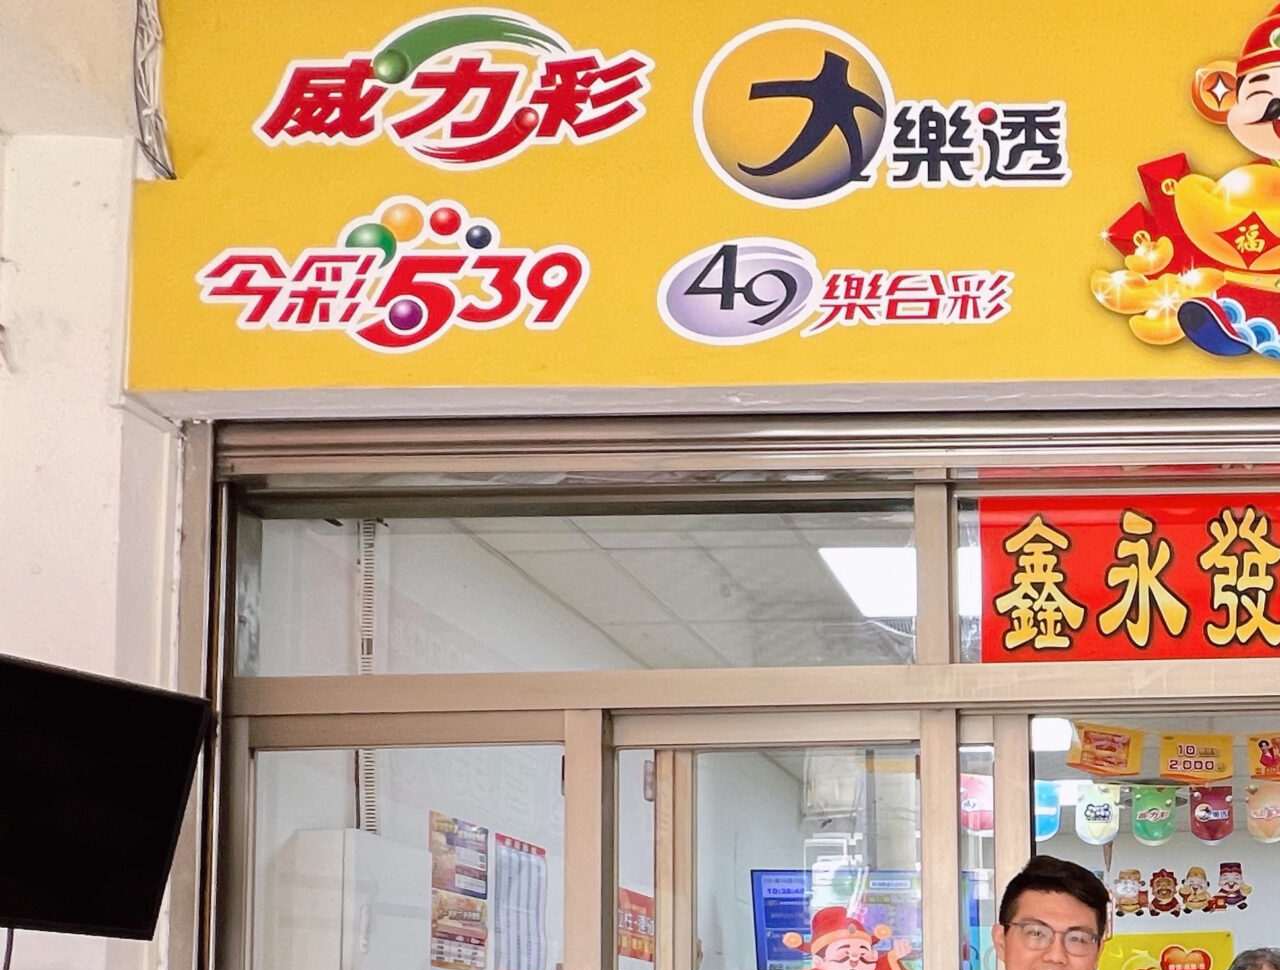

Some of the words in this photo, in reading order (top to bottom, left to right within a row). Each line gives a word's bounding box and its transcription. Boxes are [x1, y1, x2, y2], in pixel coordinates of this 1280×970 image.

[262, 55, 648, 138] 威力彩
[738, 51, 1066, 182] 大樂透
[1235, 224, 1266, 254] 福
[204, 254, 583, 347] 今彩539
